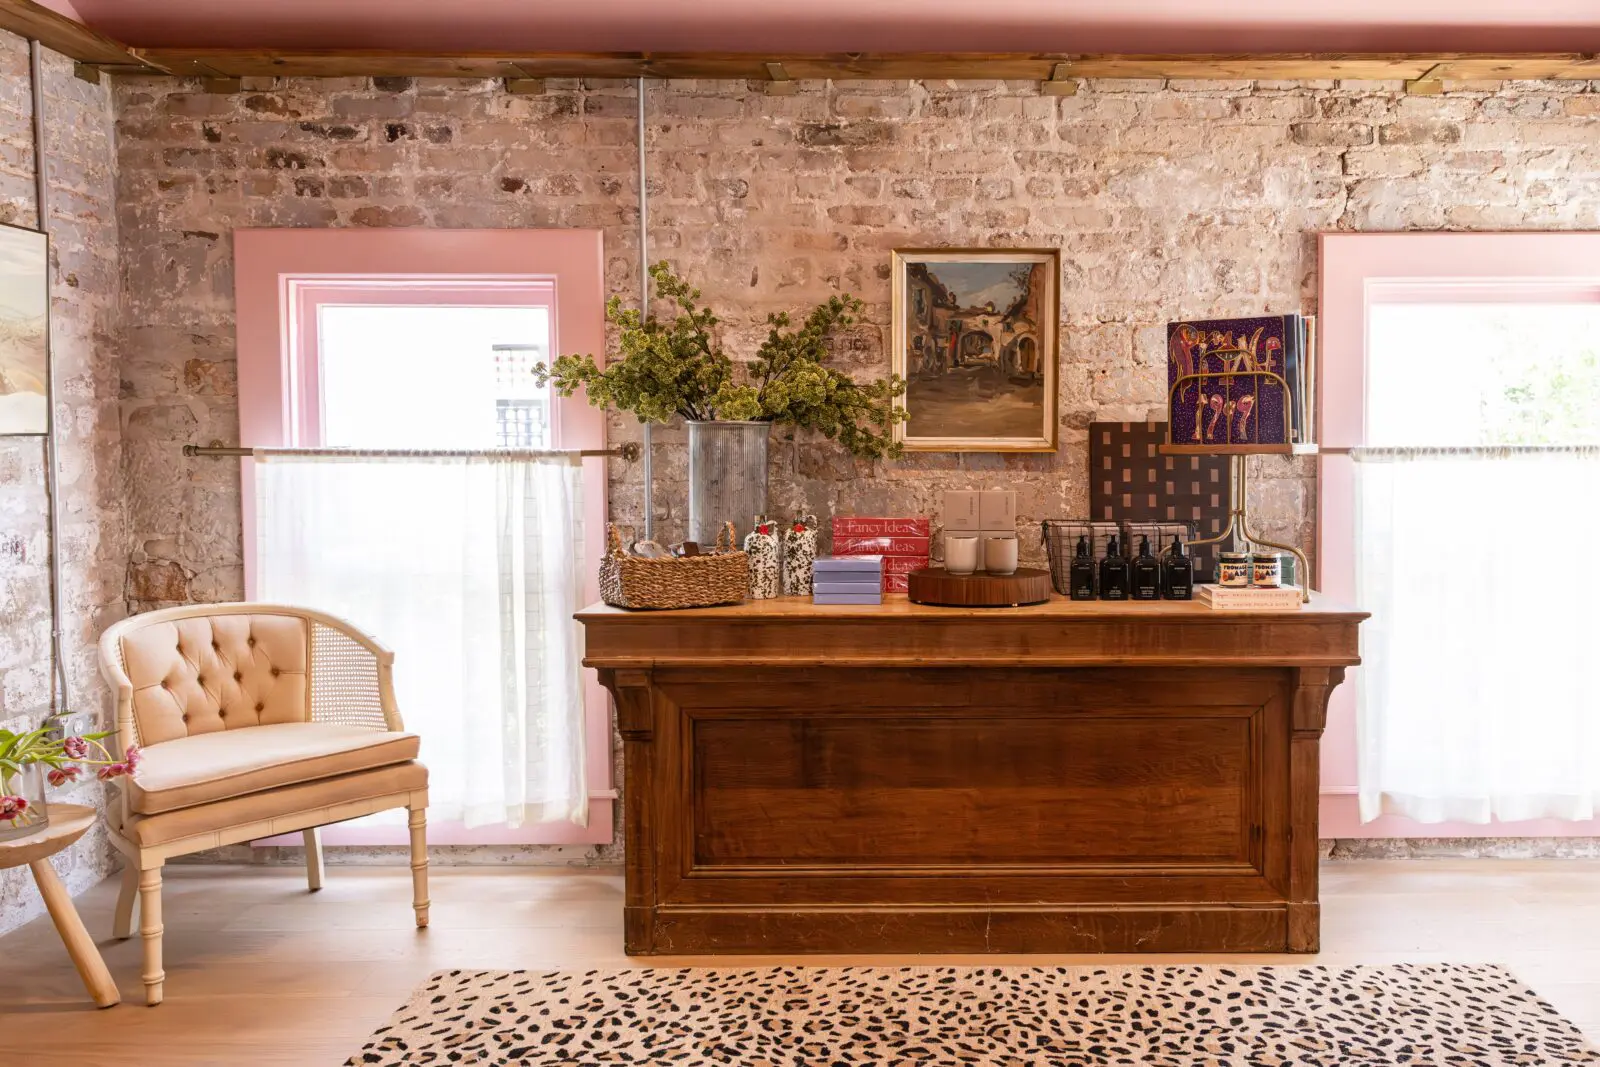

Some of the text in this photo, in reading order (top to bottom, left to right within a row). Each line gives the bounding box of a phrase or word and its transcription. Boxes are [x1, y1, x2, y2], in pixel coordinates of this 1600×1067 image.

[847, 520, 880, 536] Fancy
[884, 539, 915, 552] Ideas
[883, 558, 914, 571] Ideas
[883, 577, 908, 590] Ide
